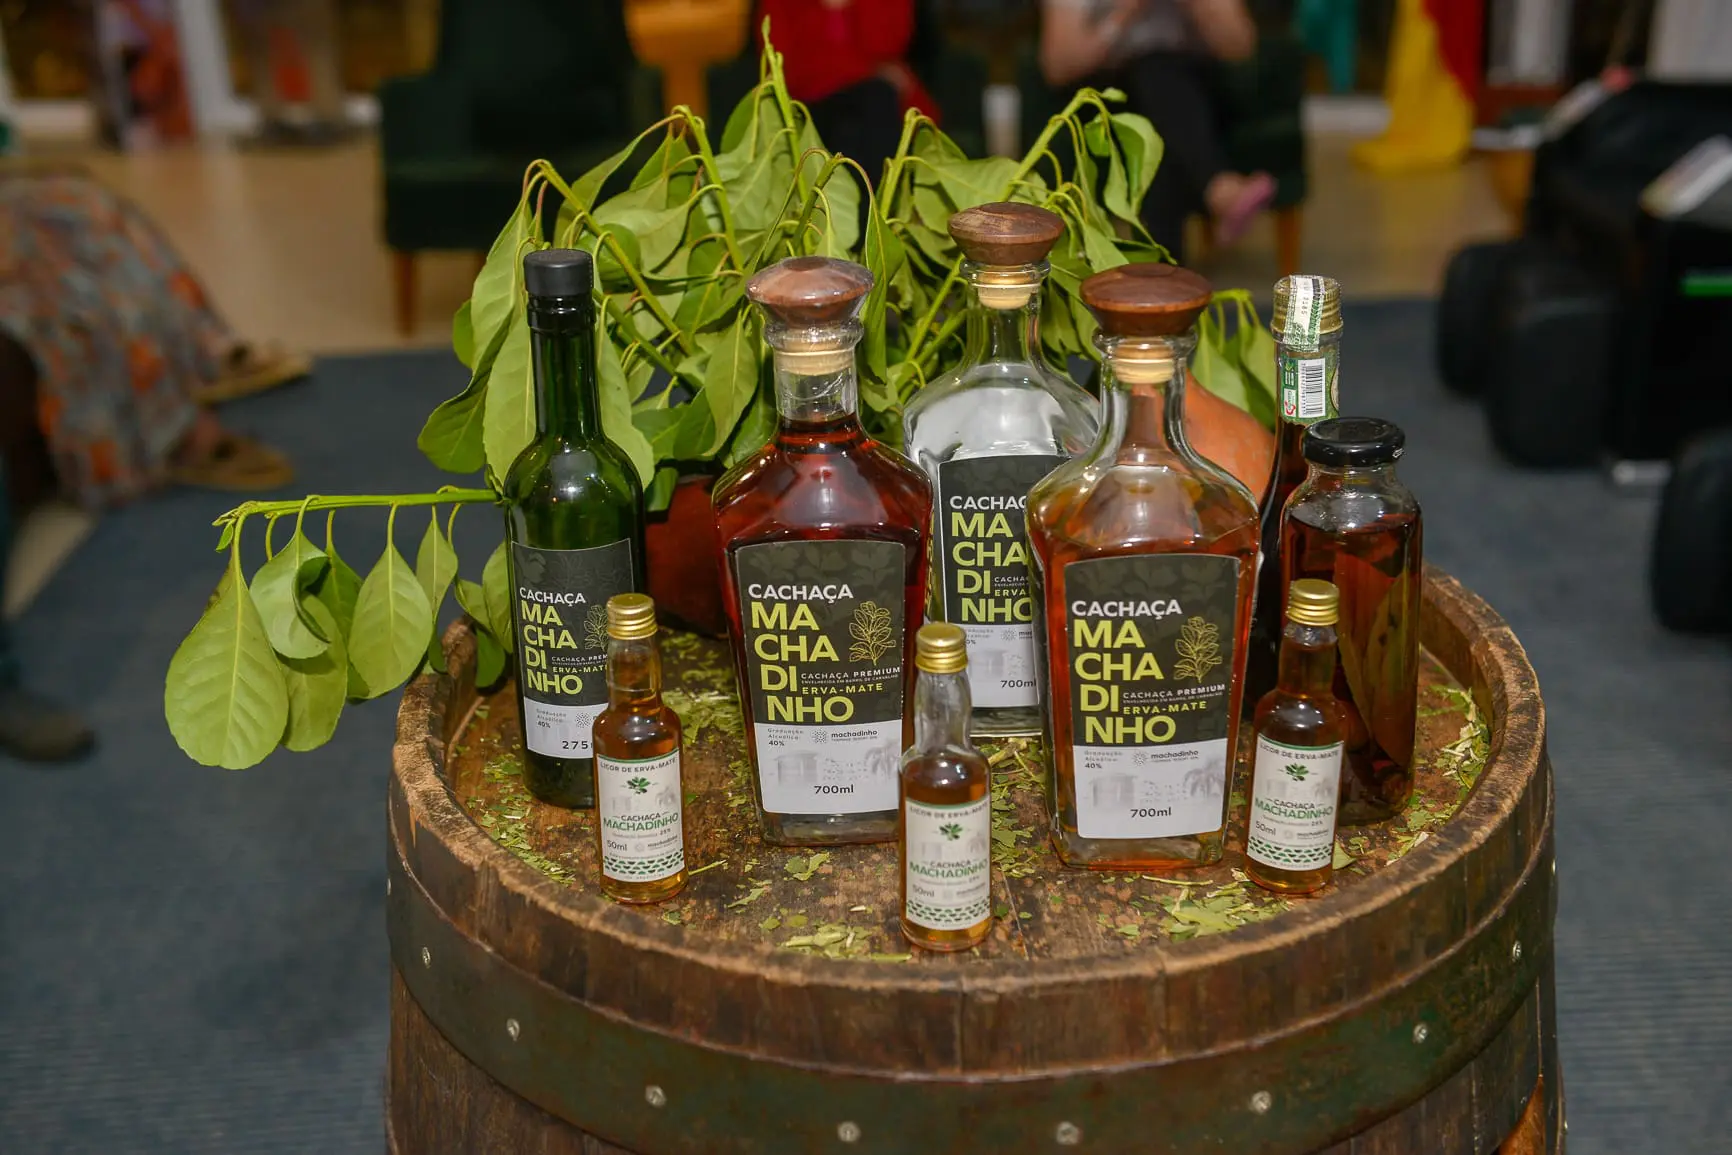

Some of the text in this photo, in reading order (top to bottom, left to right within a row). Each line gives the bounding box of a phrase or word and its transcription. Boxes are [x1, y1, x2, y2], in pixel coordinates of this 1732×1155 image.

[950, 495, 1027, 511] CACHAÇ
[951, 512, 1014, 538] MA
[952, 541, 1028, 567] CHA
[957, 569, 990, 595] DI
[519, 587, 587, 607] CACHAÇA
[748, 583, 854, 604] CACHAÇA
[521, 600, 563, 626] MA
[751, 601, 820, 631] MA
[961, 597, 1032, 623] NHO
[1071, 599, 1182, 620] CACHAÇA
[523, 624, 578, 649] CHA
[1073, 618, 1146, 649] MA
[525, 645, 547, 670] DI
[754, 633, 840, 662] CHA
[588, 654, 608, 662] PREM
[1074, 652, 1165, 681] CHA
[527, 668, 583, 695] NHO
[760, 664, 798, 692] DI
[801, 666, 901, 681] CACHAÇA PREMIUM
[1001, 678, 1037, 688] 700ml
[802, 682, 883, 695] ERVA-MATE
[1080, 683, 1119, 712] DI
[1123, 683, 1226, 700] CACHAÇA PREMIUM
[766, 695, 854, 723] NHO
[1123, 700, 1207, 715] ERVA-MATE
[831, 730, 878, 738] machadinho
[1085, 715, 1177, 744] NHO
[562, 740, 593, 750] 275
[1150, 750, 1199, 759] machadinho
[600, 761, 619, 771] LICOR
[634, 757, 676, 773] ERVA-MATE
[814, 784, 854, 795] 700ml
[1130, 807, 1172, 818] 700ml
[1255, 798, 1333, 819] MACHADINHO
[1273, 799, 1315, 810] CACHAÇA
[604, 812, 679, 831] MACHADINHO
[620, 812, 661, 822] CACHAÇA
[1255, 820, 1276, 836] 50ml
[607, 840, 627, 851] 50ml
[909, 859, 988, 878] MACHADINHO
